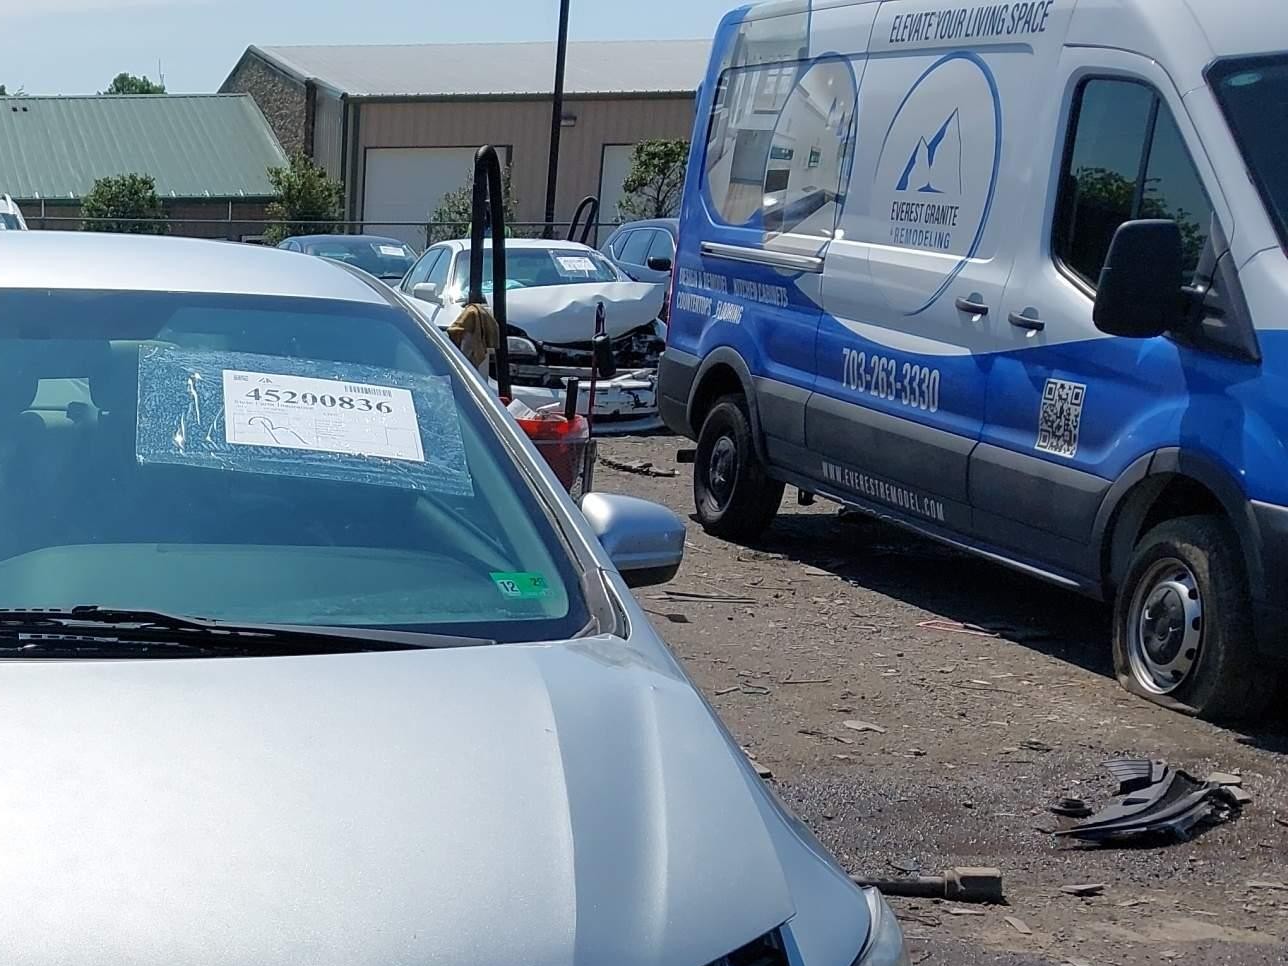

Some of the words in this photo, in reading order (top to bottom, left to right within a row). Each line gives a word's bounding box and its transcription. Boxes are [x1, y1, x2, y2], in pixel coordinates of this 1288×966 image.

[889, 12, 936, 43] ELEVATE
[934, 9, 967, 40] YOUR
[965, 4, 1009, 37] LIVING
[1007, 0, 1054, 35] SPACE
[891, 201, 925, 223] EVEREST
[924, 203, 959, 226] GRANITE
[894, 227, 951, 249] REMODELING
[842, 347, 940, 413] 703-263-3330
[245, 387, 393, 414] 45200836
[822, 460, 945, 521] WWW.EVERESTREMODEL.COM
[499, 580, 520, 592] 12
